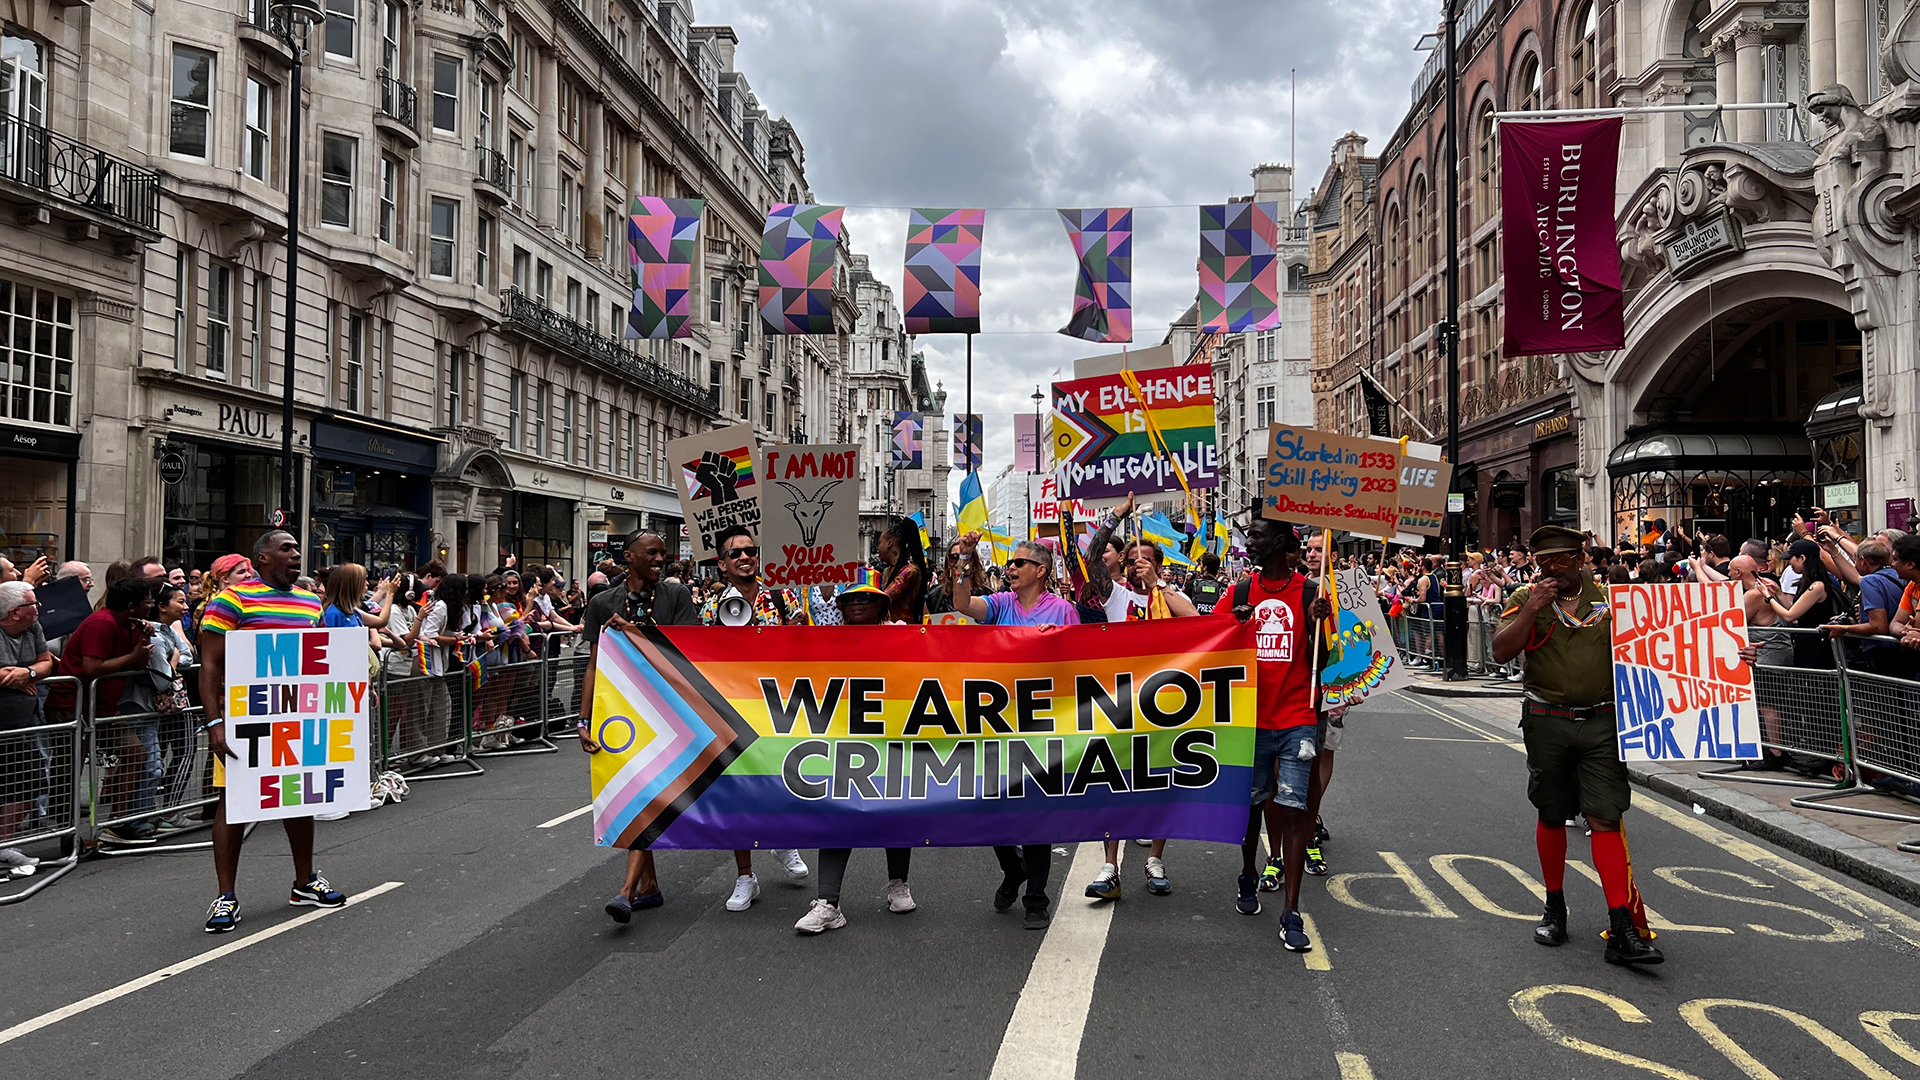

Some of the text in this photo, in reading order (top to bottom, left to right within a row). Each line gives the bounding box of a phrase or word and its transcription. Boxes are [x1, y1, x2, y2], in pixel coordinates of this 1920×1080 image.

[1536, 202, 1552, 279] ARCADE
[1555, 143, 1583, 331] BURLINGTON
[1673, 225, 1720, 258] BURLINGTON
[1689, 242, 1710, 258] ARCADE
[1057, 389, 1090, 413] MY
[218, 403, 275, 439] PAUL
[1124, 409, 1146, 433] IS
[161, 461, 183, 470] PAUL
[766, 450, 856, 480] I AM NOT
[1275, 429, 1395, 471] Started in 1533
[1268, 462, 1397, 497] Still fighting 2023
[1400, 466, 1438, 488] LIFE
[1894, 460, 1907, 482] 51
[611, 487, 625, 501] Case
[693, 497, 758, 522] WE PERSIST
[698, 508, 761, 534] WHEN YOU
[1344, 504, 1399, 529] Sexuality
[782, 543, 835, 568] YOUR
[763, 561, 858, 587] SCAPEGOAT
[1354, 566, 1371, 589] A
[1610, 580, 1739, 646] EQUALITY
[255, 631, 330, 678] ME
[1256, 648, 1290, 659] RIMINAL
[1280, 634, 1289, 649] A
[1614, 608, 1752, 686] RIGHTS
[229, 682, 367, 717] BEING MY
[759, 665, 1247, 736] WE ARE NOT
[1615, 663, 1752, 732] AND JUSTICE
[235, 718, 355, 769] TRUE
[1619, 704, 1759, 761] FOR ALL
[781, 730, 1220, 800] CRIMINALS
[260, 768, 345, 809] SELF
